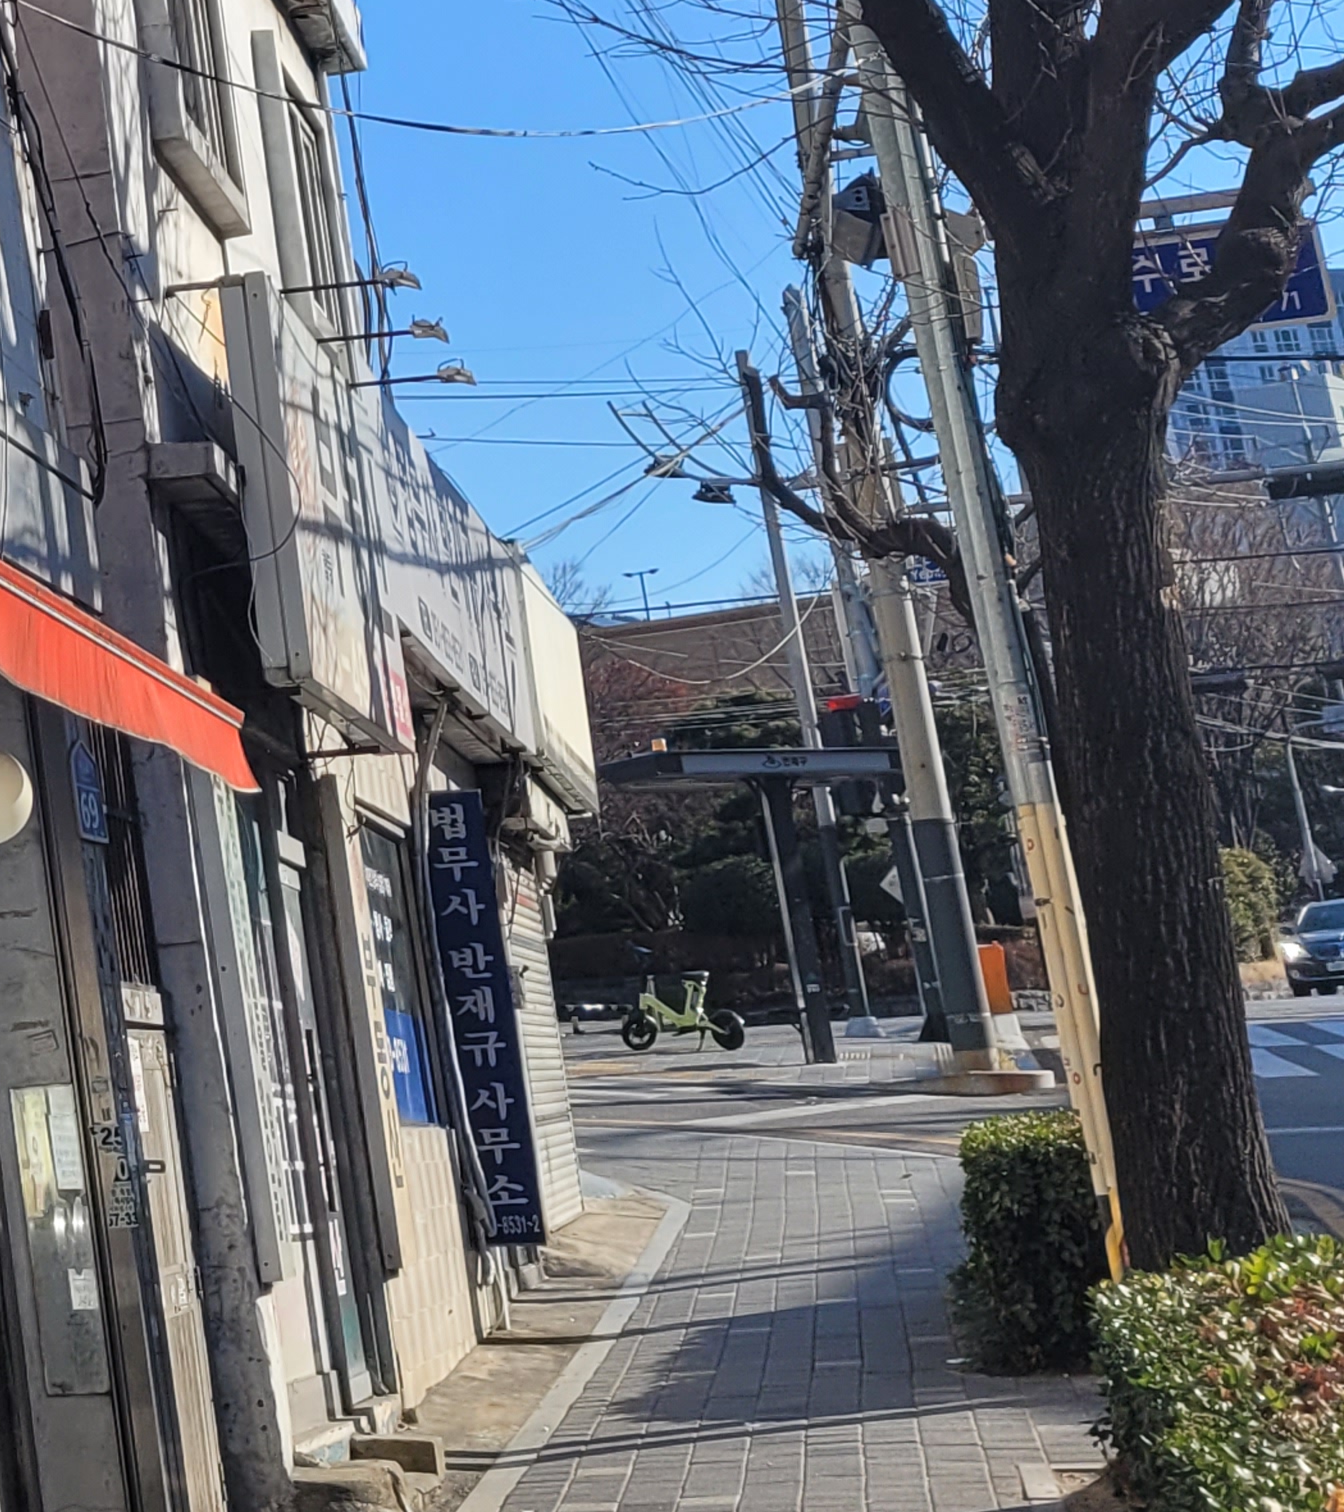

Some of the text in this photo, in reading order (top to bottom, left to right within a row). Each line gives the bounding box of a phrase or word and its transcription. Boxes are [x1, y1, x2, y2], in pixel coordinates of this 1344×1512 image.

[80, 791, 100, 829] 69
[429, 802, 530, 1207] 법무사 반재규 사무소
